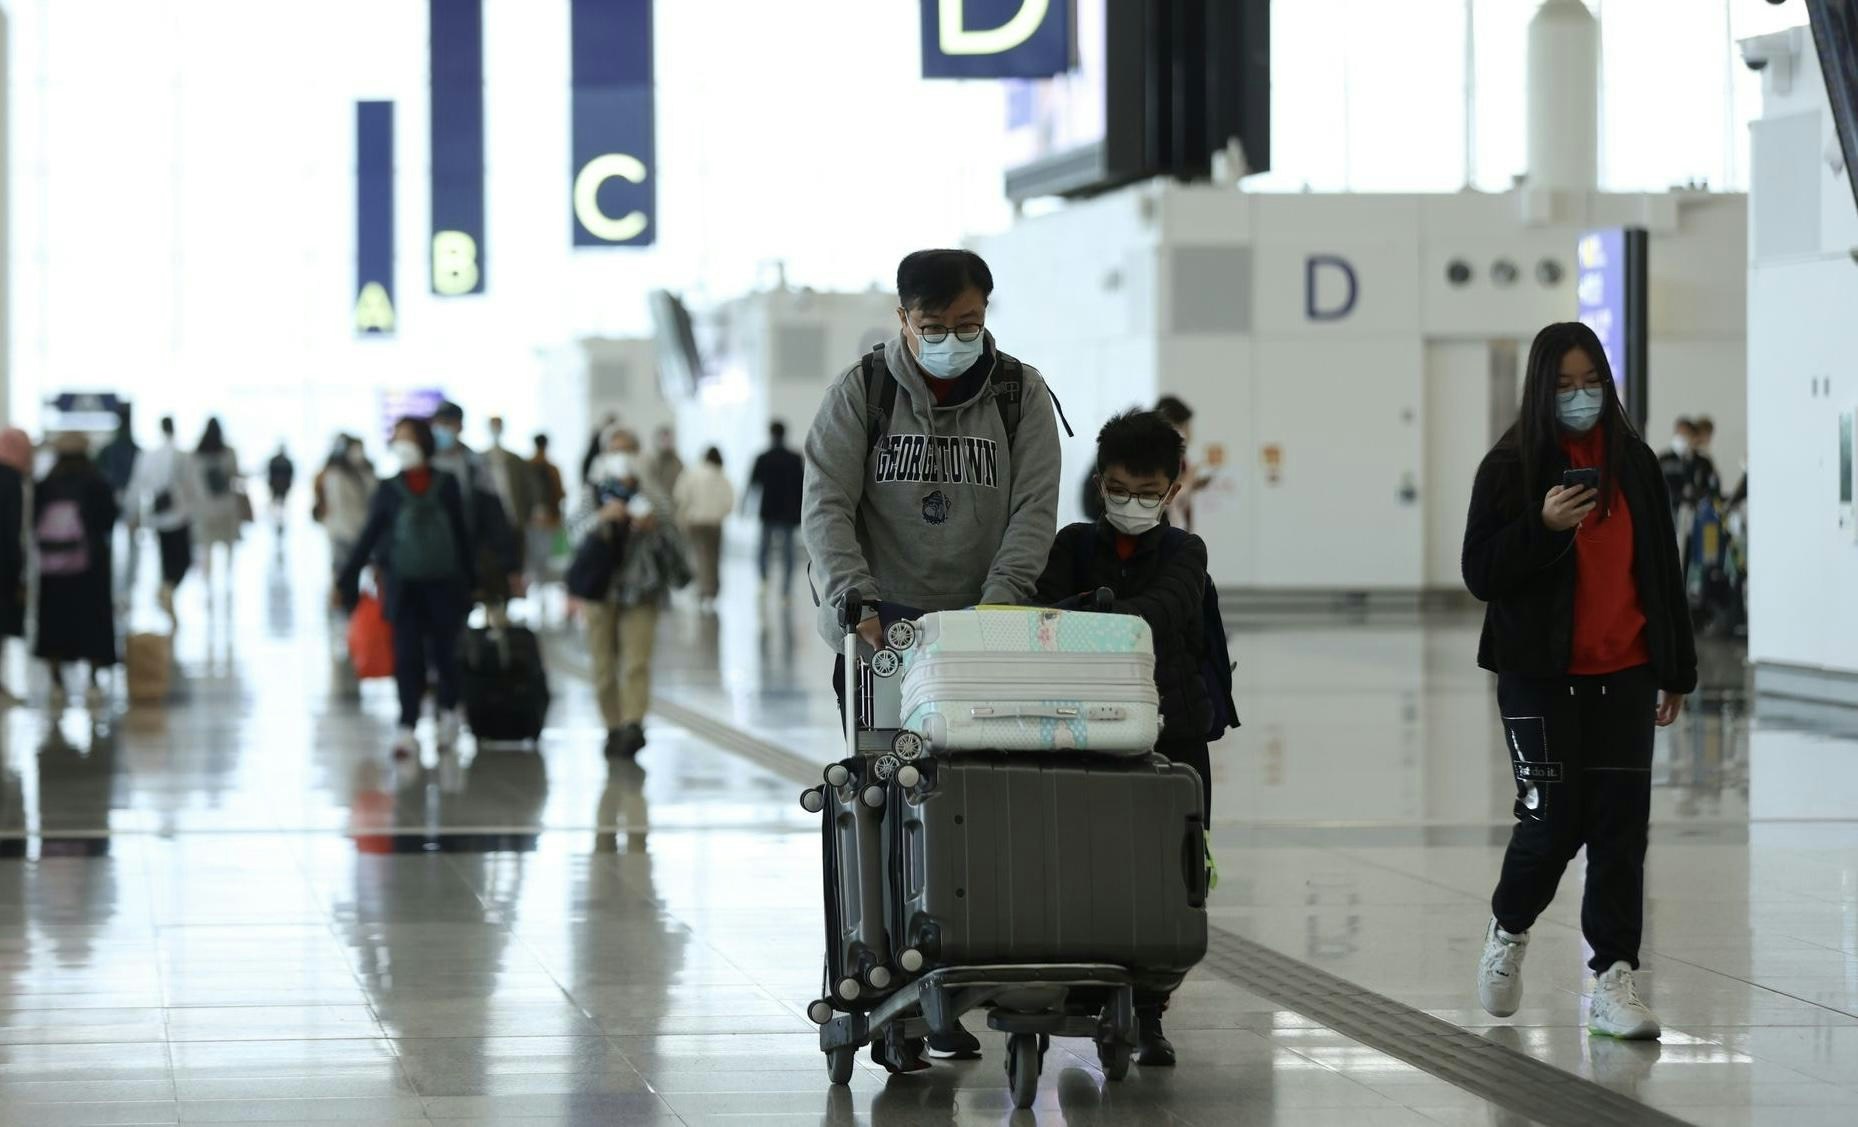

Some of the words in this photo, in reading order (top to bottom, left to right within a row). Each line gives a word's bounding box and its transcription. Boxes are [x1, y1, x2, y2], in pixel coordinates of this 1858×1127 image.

[574, 153, 648, 241] C
[432, 230, 479, 296] B
[1304, 255, 1360, 322] D
[356, 281, 396, 332] A
